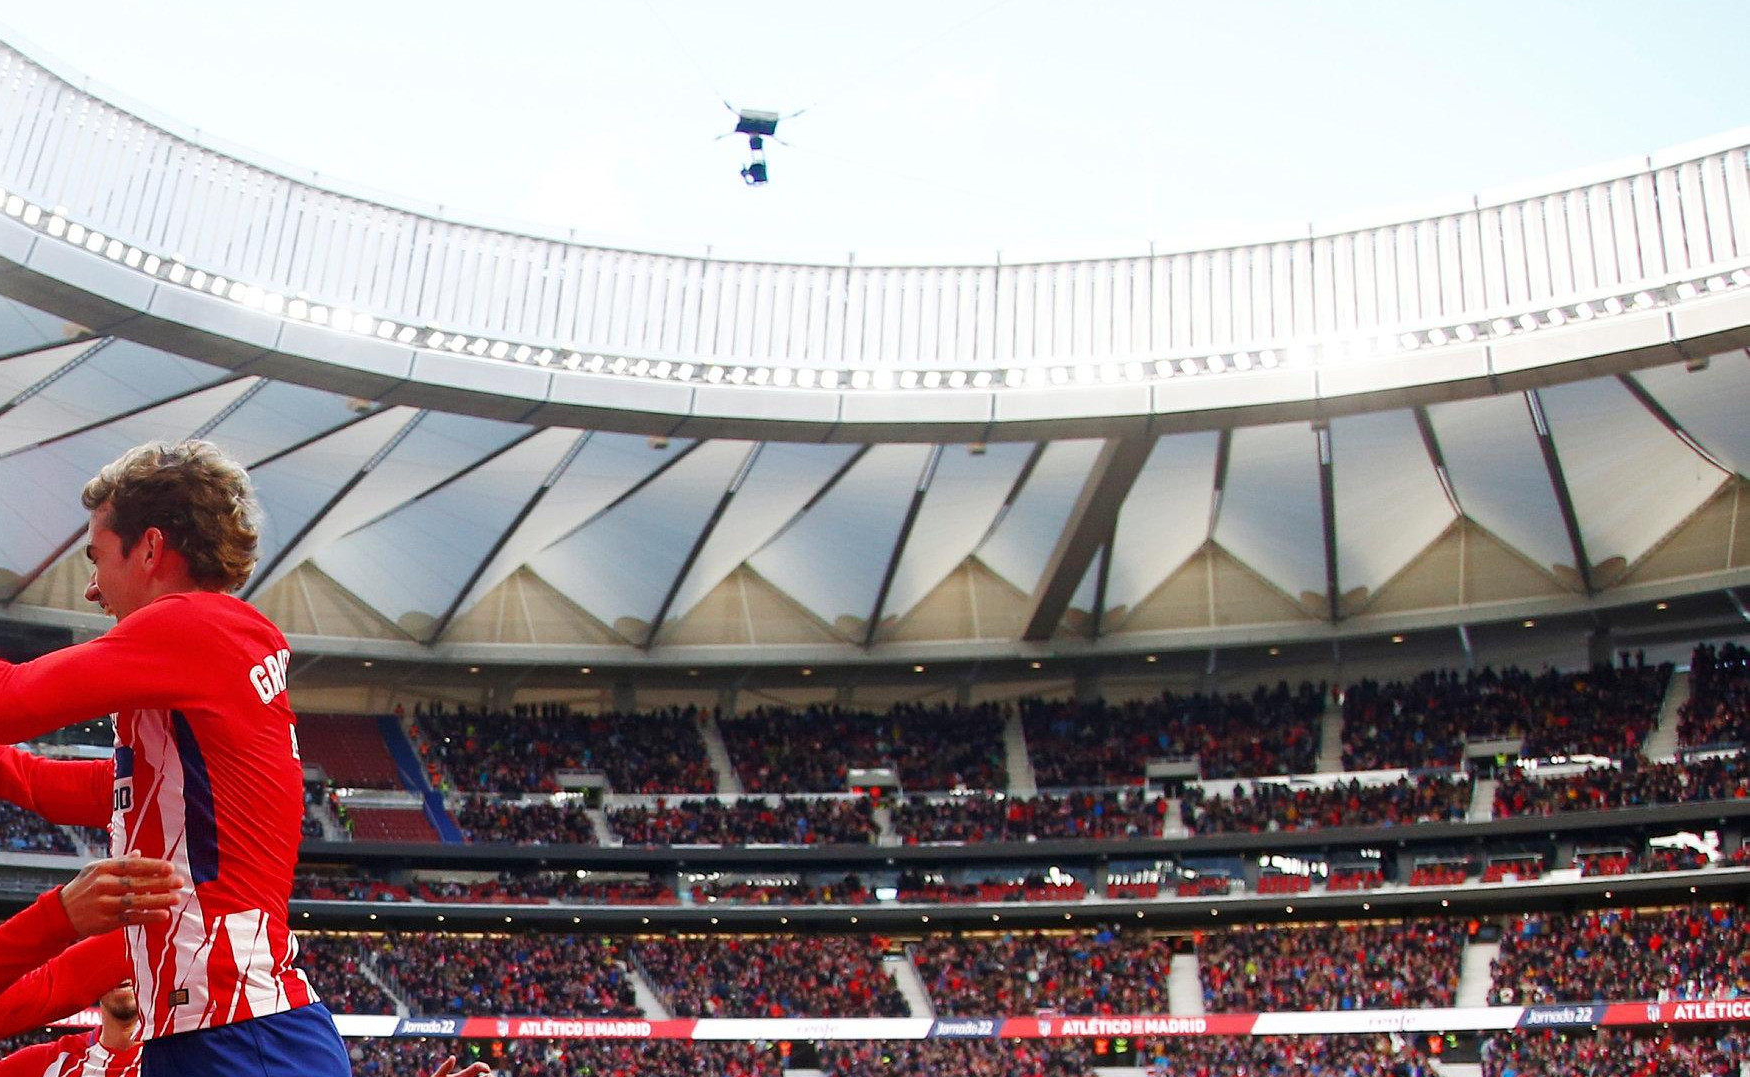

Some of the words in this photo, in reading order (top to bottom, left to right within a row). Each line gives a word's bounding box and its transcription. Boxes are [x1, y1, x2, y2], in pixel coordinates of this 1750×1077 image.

[1061, 1016, 1132, 1034] ATLÉTICO
[1144, 1018, 1207, 1034] MADRID
[1526, 1008, 1575, 1025] Jornada
[1575, 1007, 1593, 1024] 22
[401, 1019, 441, 1035] Jornada
[440, 1020, 456, 1034] 22
[518, 1019, 583, 1037] ATLÉTICO
[596, 1022, 651, 1037] MADRID
[936, 1021, 976, 1036] Jornada
[975, 1021, 994, 1036] 22
